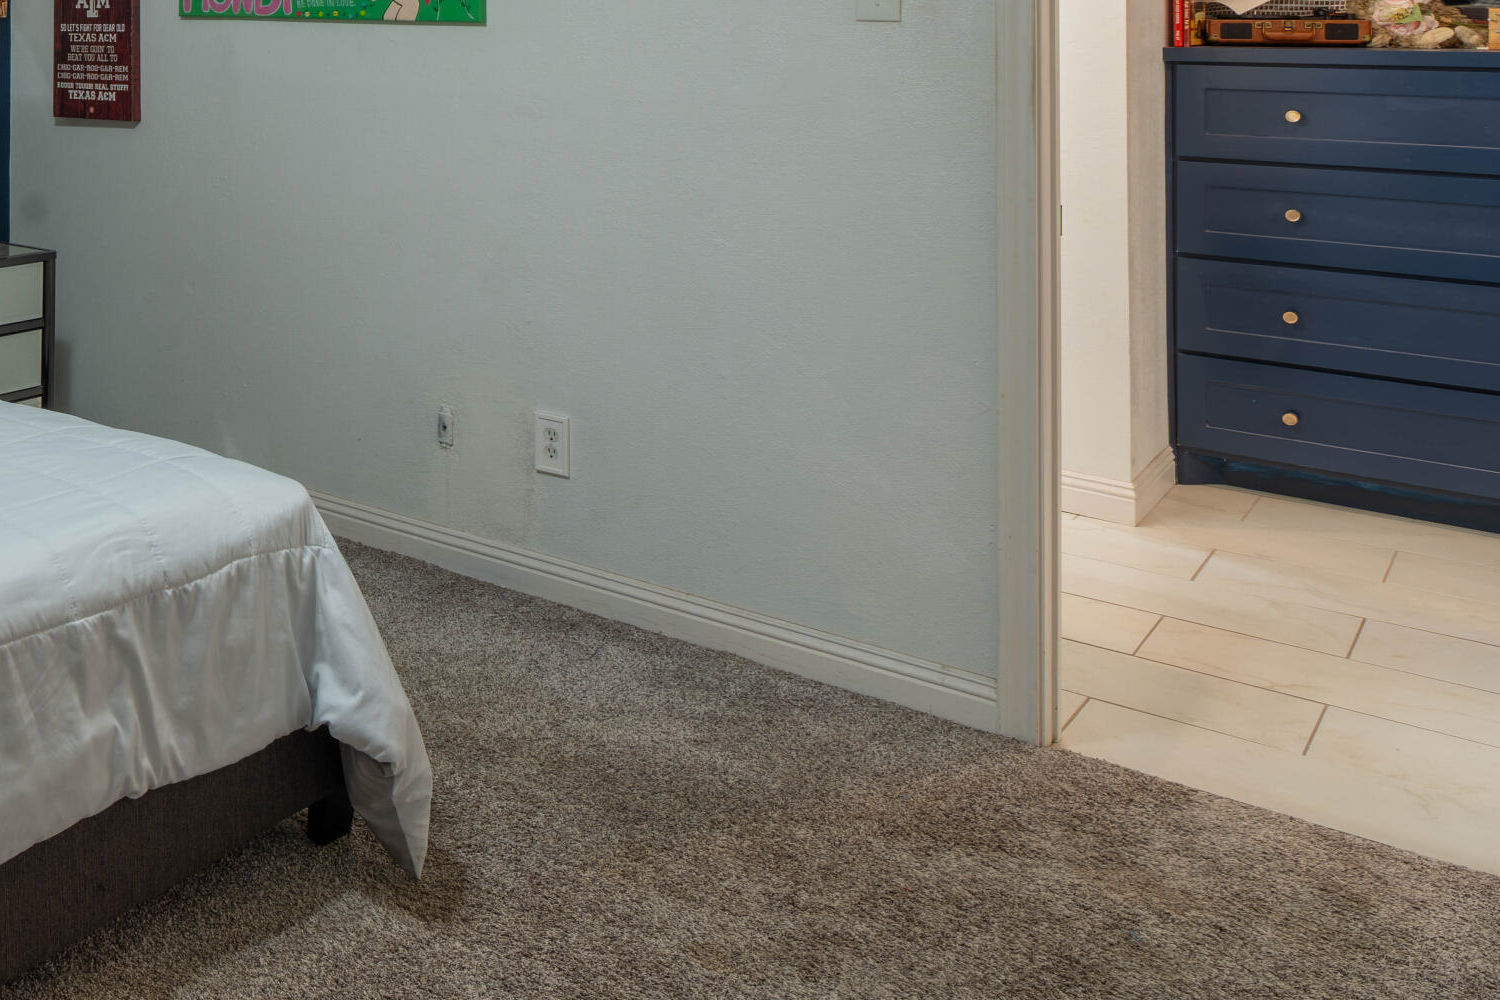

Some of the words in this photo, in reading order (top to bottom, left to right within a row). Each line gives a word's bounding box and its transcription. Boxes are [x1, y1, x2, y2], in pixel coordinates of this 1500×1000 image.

[60, 23, 67, 32] SO
[93, 23, 102, 32] FOR
[102, 23, 116, 32] DEAR
[116, 23, 126, 33] OLD
[68, 33, 97, 43] TEXAS
[106, 45, 115, 54] TO
[67, 53, 82, 62] BEAT
[83, 53, 96, 62] YOU
[97, 53, 109, 62] ALL
[109, 54, 118, 62] TO
[94, 83, 109, 91] REAL
[68, 90, 96, 100] TEXAS
